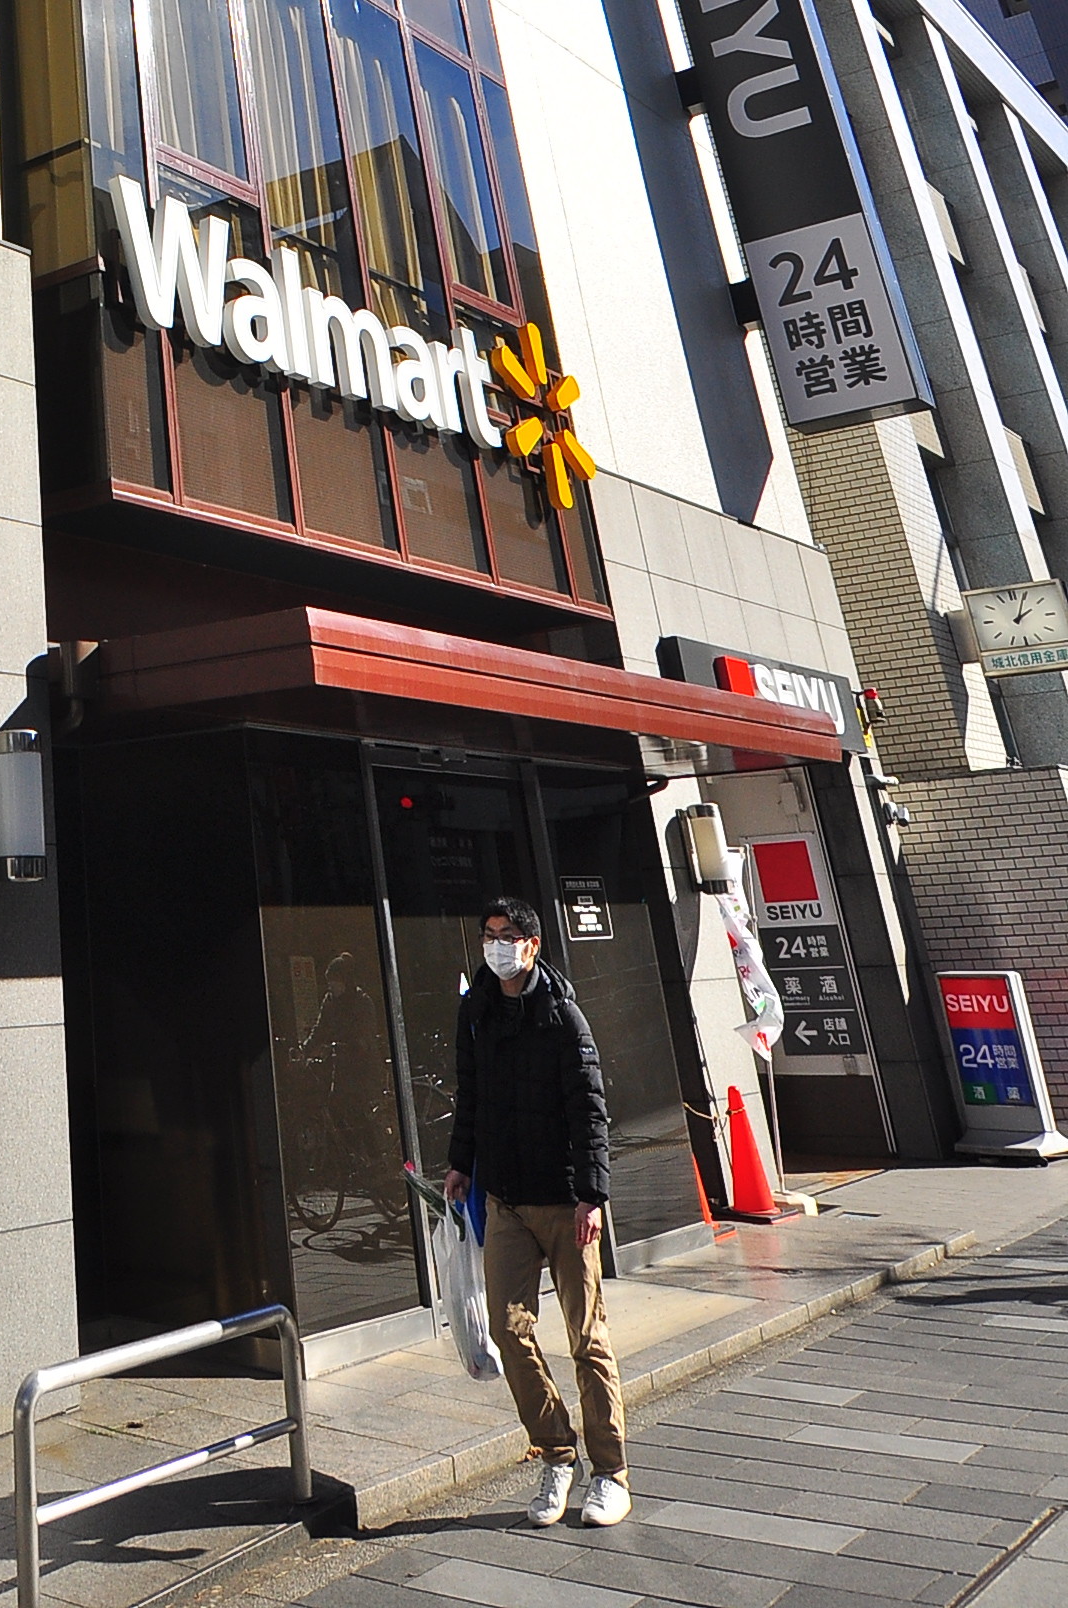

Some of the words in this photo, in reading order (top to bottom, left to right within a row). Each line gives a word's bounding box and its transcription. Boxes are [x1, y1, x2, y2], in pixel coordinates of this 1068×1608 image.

[768, 237, 859, 308] 24
[109, 175, 502, 449] Walmart
[783, 299, 874, 351] 時間
[796, 343, 888, 399] 営業
[754, 663, 845, 735] SEIYU
[766, 902, 823, 921] SEIYU
[775, 936, 807, 959] 24
[819, 975, 837, 993] 酒
[945, 994, 1009, 1012] SEIYU
[828, 1032, 850, 1045] 入口
[959, 1044, 994, 1069] 24
